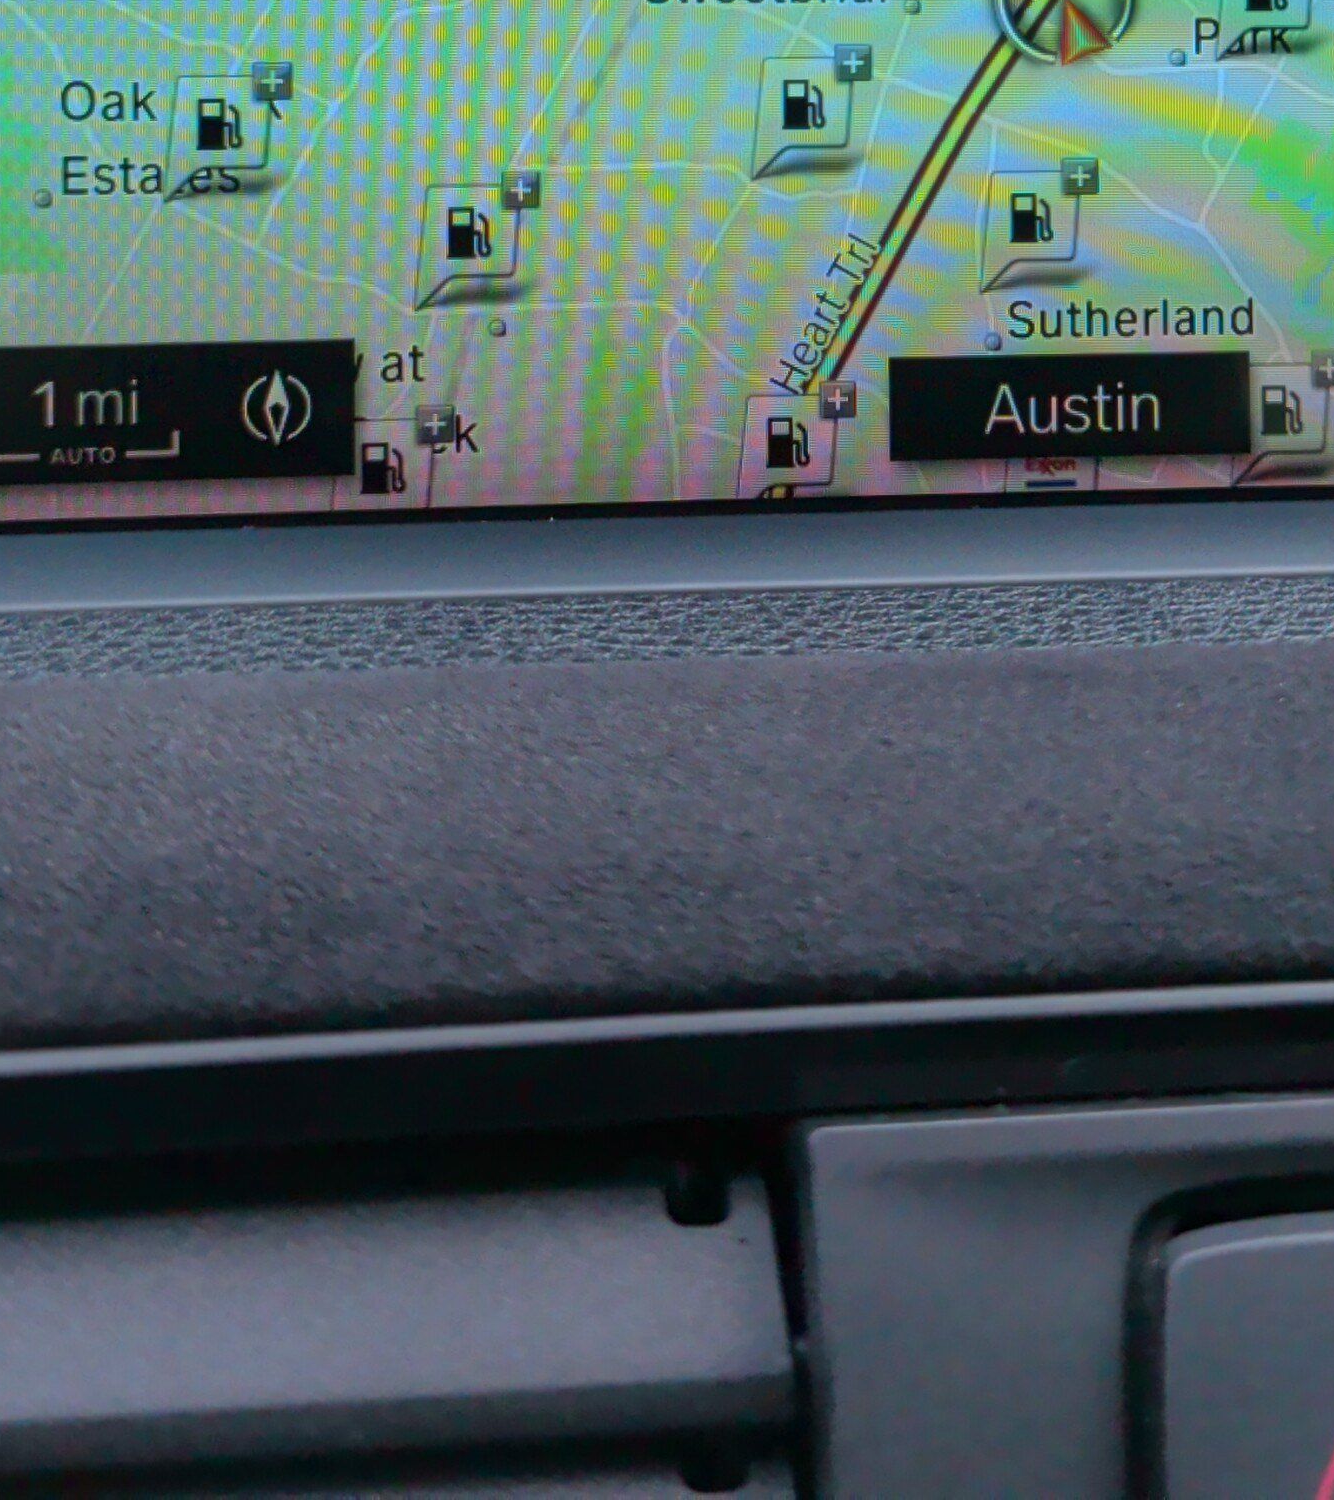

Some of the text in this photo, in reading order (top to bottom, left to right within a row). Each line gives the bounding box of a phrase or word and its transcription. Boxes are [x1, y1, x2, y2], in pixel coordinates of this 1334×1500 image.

[61, 79, 158, 123] Oak
[61, 155, 242, 196] Estaes
[769, 232, 880, 397] Heart Trl
[1007, 298, 1255, 341] Sutherland
[380, 343, 426, 384] at
[31, 376, 140, 428] 1 mi
[983, 380, 1163, 436] Austin
[49, 446, 118, 466] AUTO
